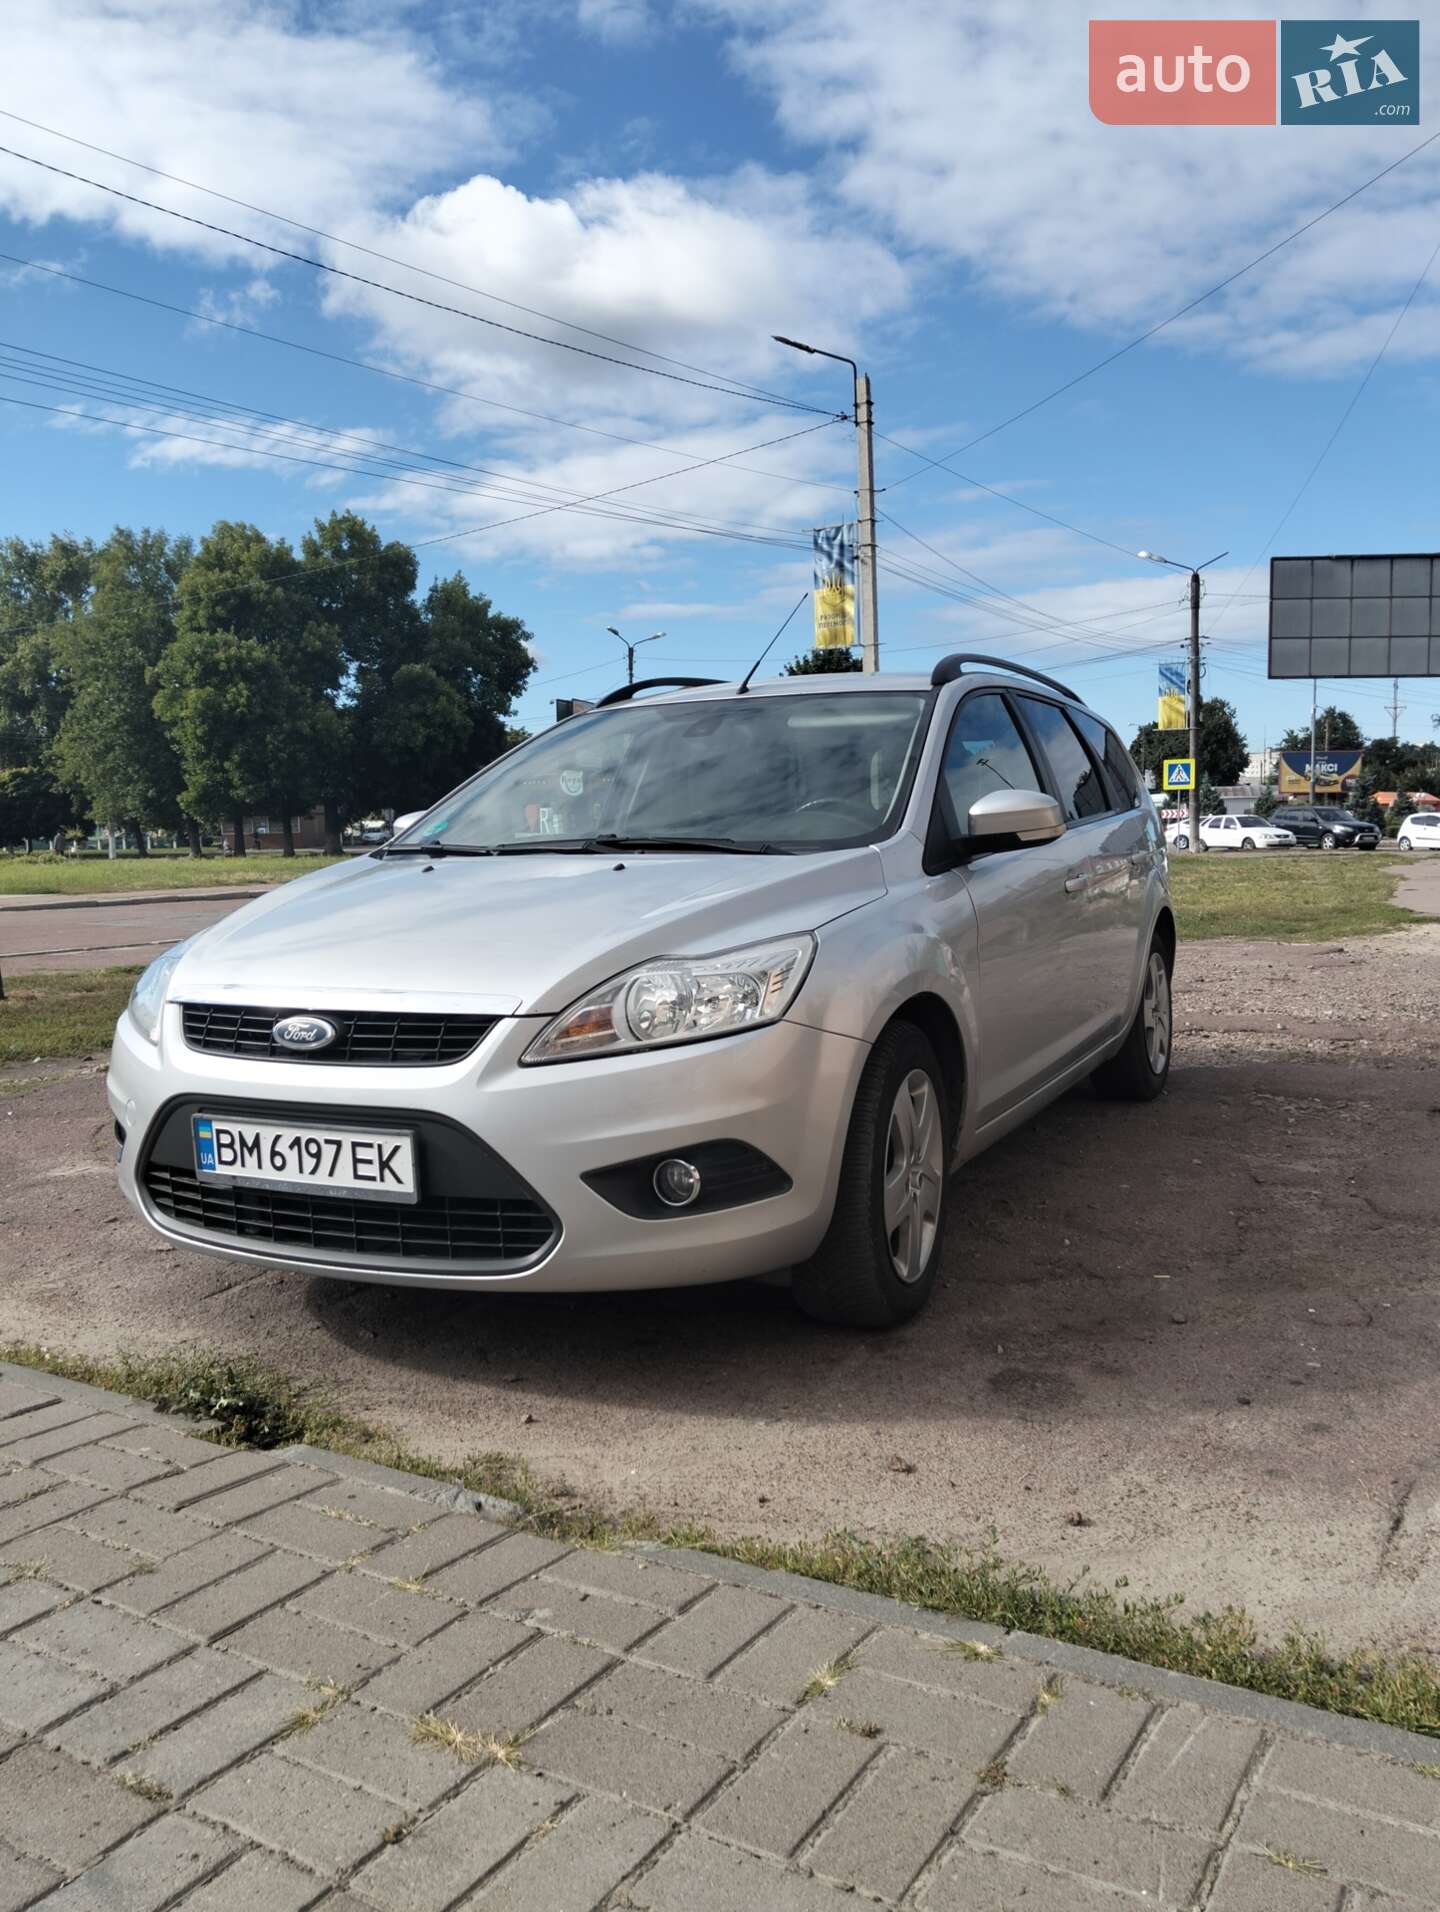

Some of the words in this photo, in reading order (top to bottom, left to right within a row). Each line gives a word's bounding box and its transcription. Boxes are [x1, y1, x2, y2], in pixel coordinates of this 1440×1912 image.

[283, 1022, 317, 1041] Ford
[201, 1152, 214, 1165] UA
[269, 1134, 342, 1177] 6197
[351, 1141, 404, 1184] EK
